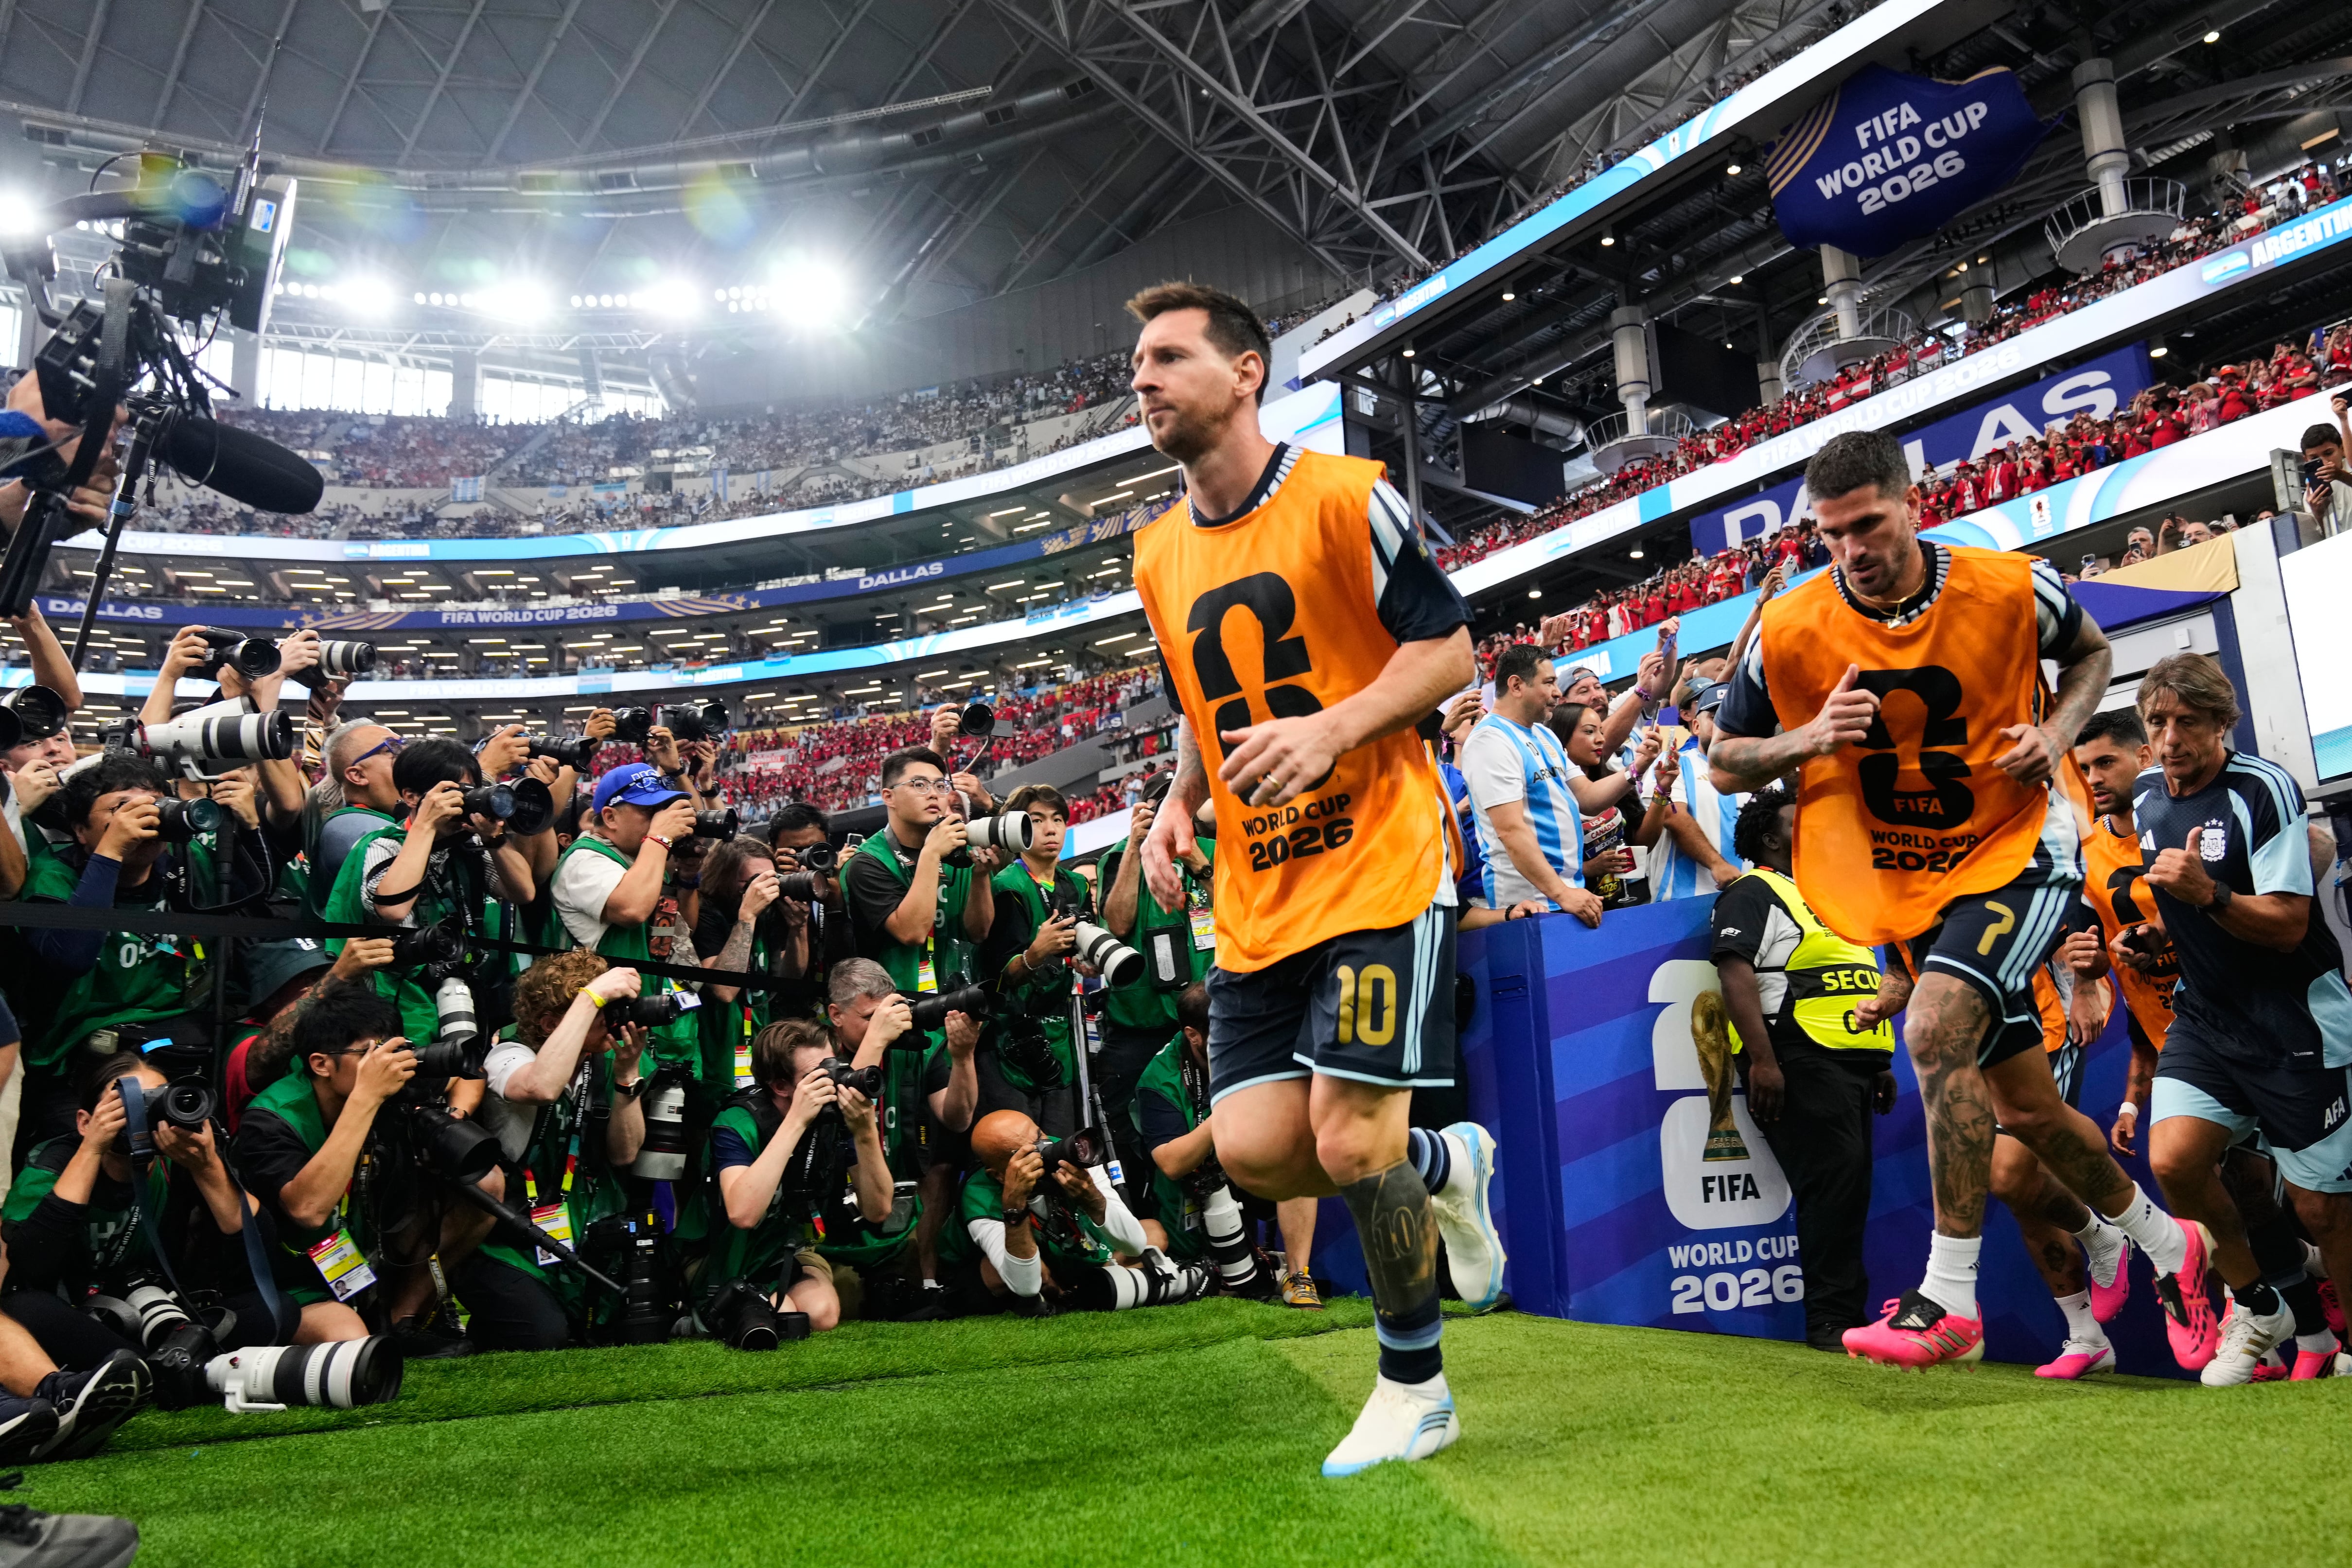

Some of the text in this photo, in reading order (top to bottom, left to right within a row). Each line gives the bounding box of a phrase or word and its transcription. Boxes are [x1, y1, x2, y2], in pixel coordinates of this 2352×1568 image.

[1855, 101, 1921, 149] FIFA
[1815, 101, 1988, 200] WORLD CUP
[1856, 150, 1966, 215] 2026
[1759, 434, 1800, 467] FIFA
[1885, 381, 1931, 414] CUP
[1932, 347, 2021, 398] 2026
[981, 433, 1134, 491] FIFA WORLD CUP 2026
[859, 562, 944, 589] DALLAS
[441, 604, 618, 624] FIFA WORLD CUP 2026
[409, 685, 442, 696] FIFA
[444, 684, 492, 695] WORLD
[494, 683, 524, 694] CUP
[1242, 793, 1351, 837] WORLD CUP
[1893, 796, 1944, 815] FIFA
[1589, 816, 1605, 827] USA
[1590, 822, 1615, 839] CANADA
[1249, 817, 1354, 872] 2026
[1594, 835, 1616, 852] MEXICO
[1870, 829, 1980, 849] WORLD CUP
[1599, 881, 1618, 893] 2026
[1976, 901, 2016, 956] 7
[1336, 964, 1396, 1046] 10
[2324, 1095, 2346, 1129] AFA
[805, 1151, 814, 1169] WORLD
[1702, 1173, 1761, 1203] FIFA
[129, 1206, 141, 1232] WORLD
[1668, 1235, 1798, 1268] WORLD CUP
[1196, 1275, 1209, 1296] Canon
[1670, 1265, 1803, 1314] 2026
